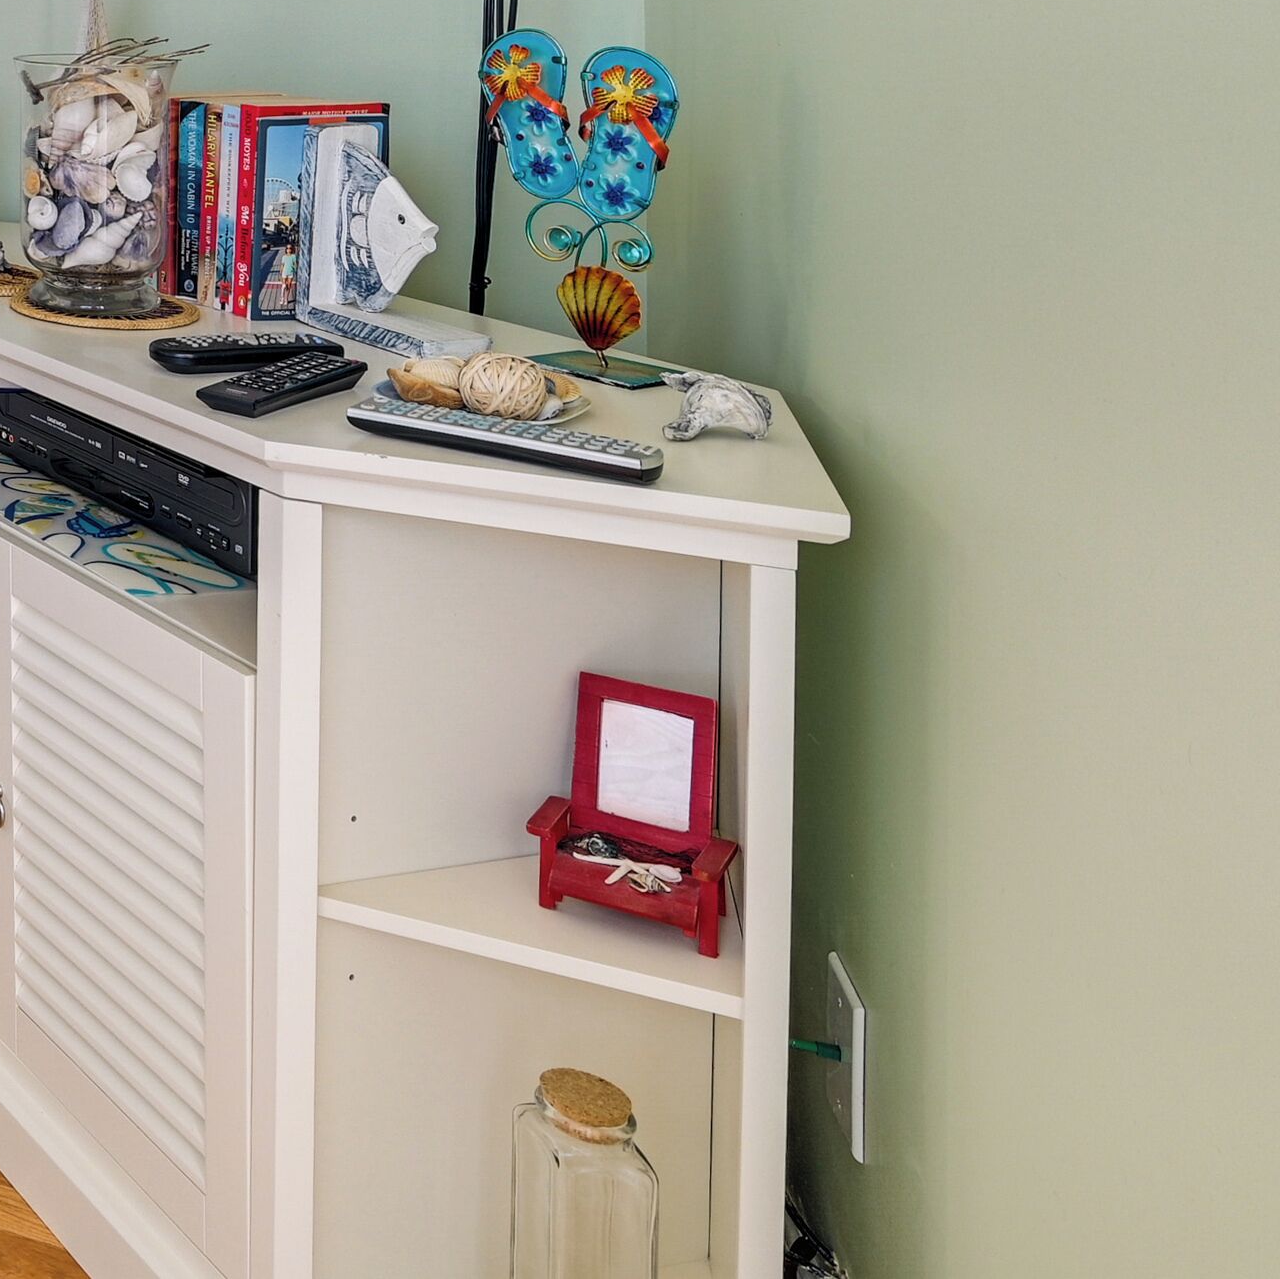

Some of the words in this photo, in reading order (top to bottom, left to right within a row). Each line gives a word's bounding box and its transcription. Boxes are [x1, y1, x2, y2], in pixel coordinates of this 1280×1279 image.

[188, 109, 197, 128] THE
[244, 109, 252, 136] JOJO
[187, 131, 196, 168] WOMAN
[206, 114, 217, 158] HILARY
[243, 137, 252, 171] MOYES
[187, 170, 196, 180] IN
[204, 161, 216, 209] MANTEL
[187, 182, 196, 210] CABIN
[241, 205, 250, 225] Me
[190, 229, 199, 251] RUTH
[241, 228, 249, 261] Before
[190, 253, 199, 276] WARE
[237, 262, 250, 287] You
